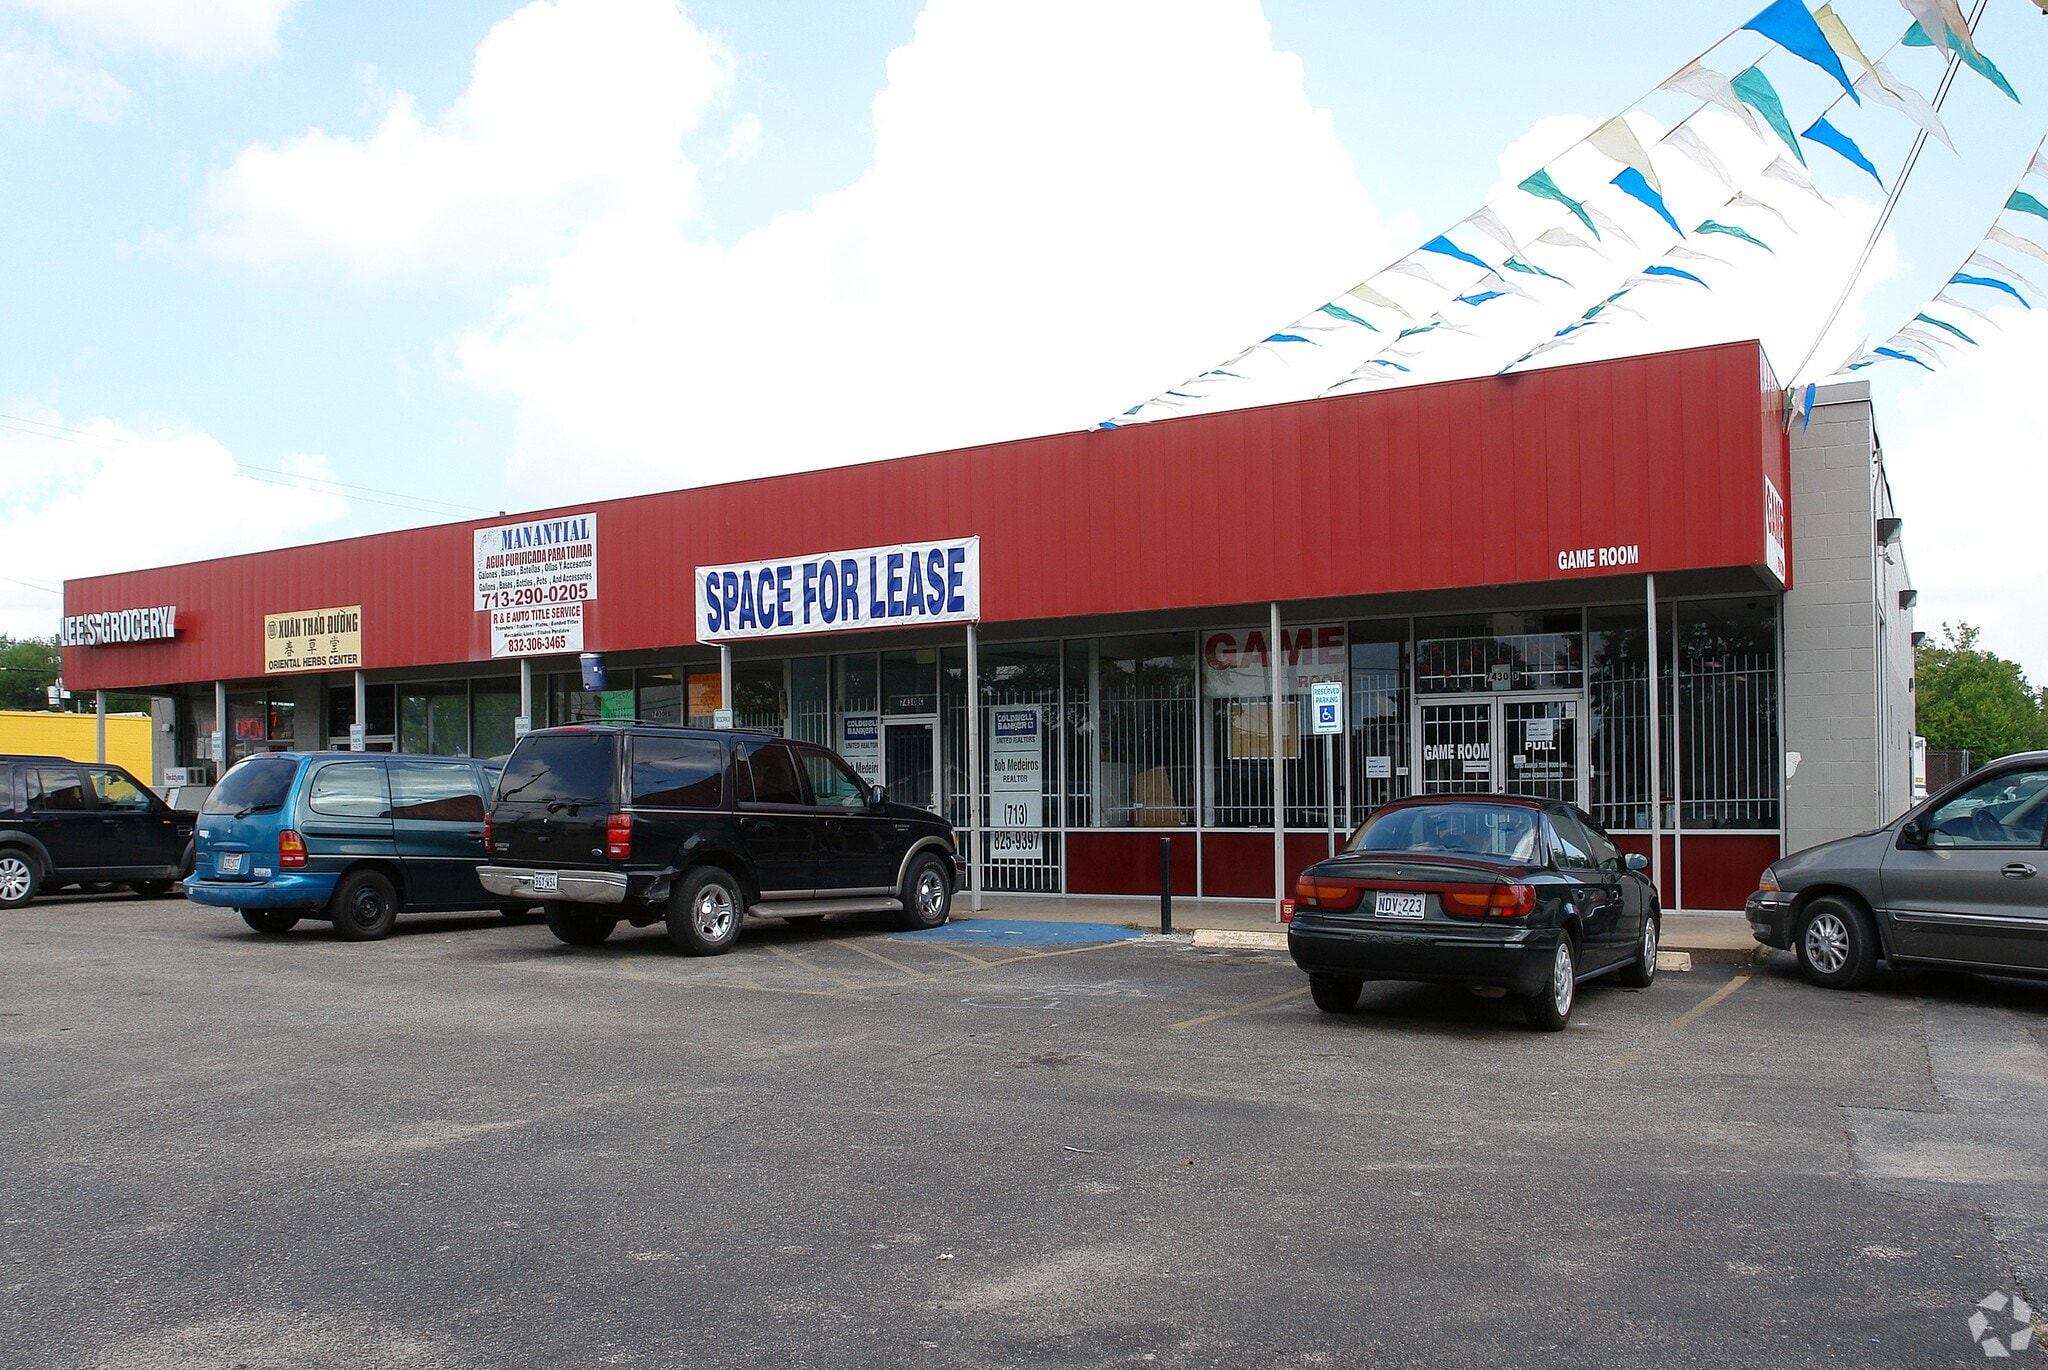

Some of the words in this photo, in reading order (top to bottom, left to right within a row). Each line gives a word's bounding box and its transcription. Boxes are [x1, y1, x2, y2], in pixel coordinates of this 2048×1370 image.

[501, 518, 590, 550] MANANTIAL
[486, 555, 504, 569] AGUA
[505, 549, 547, 566] PURIFICADA
[548, 547, 566, 562] PARA
[566, 544, 592, 559] TOMAR
[1558, 548, 1596, 570] GAME
[1599, 545, 1639, 566] ROOM
[482, 583, 588, 609] 713-290-0205
[706, 566, 794, 633] SPACE
[802, 559, 859, 624] FOR
[869, 547, 966, 619] LEASE
[493, 613, 498, 624] R
[500, 613, 505, 623] &
[506, 612, 511, 623] E
[512, 610, 529, 623] AUTO
[531, 608, 550, 621] TITLE
[551, 606, 580, 618] SERVICE
[61, 613, 99, 647] LEE'S
[101, 606, 175, 643] GROCERY
[508, 636, 566, 653] 832-306-3465
[1204, 627, 1345, 670] GAME
[268, 658, 301, 670] ORIENTAL
[303, 655, 326, 667] HERBS
[328, 654, 358, 665] CENTER
[997, 713, 1033, 722] COLDWELL
[997, 721, 1027, 731] BANKER
[1424, 744, 1455, 760] GAME
[1457, 743, 1490, 759] ROOM
[1524, 741, 1556, 750] PULL
[994, 759, 1006, 771] Bob
[1007, 758, 1039, 771] Medeiros
[1004, 803, 1027, 826] (713)
[994, 831, 1039, 850] 825-9397
[1353, 933, 1431, 946] SATURN
